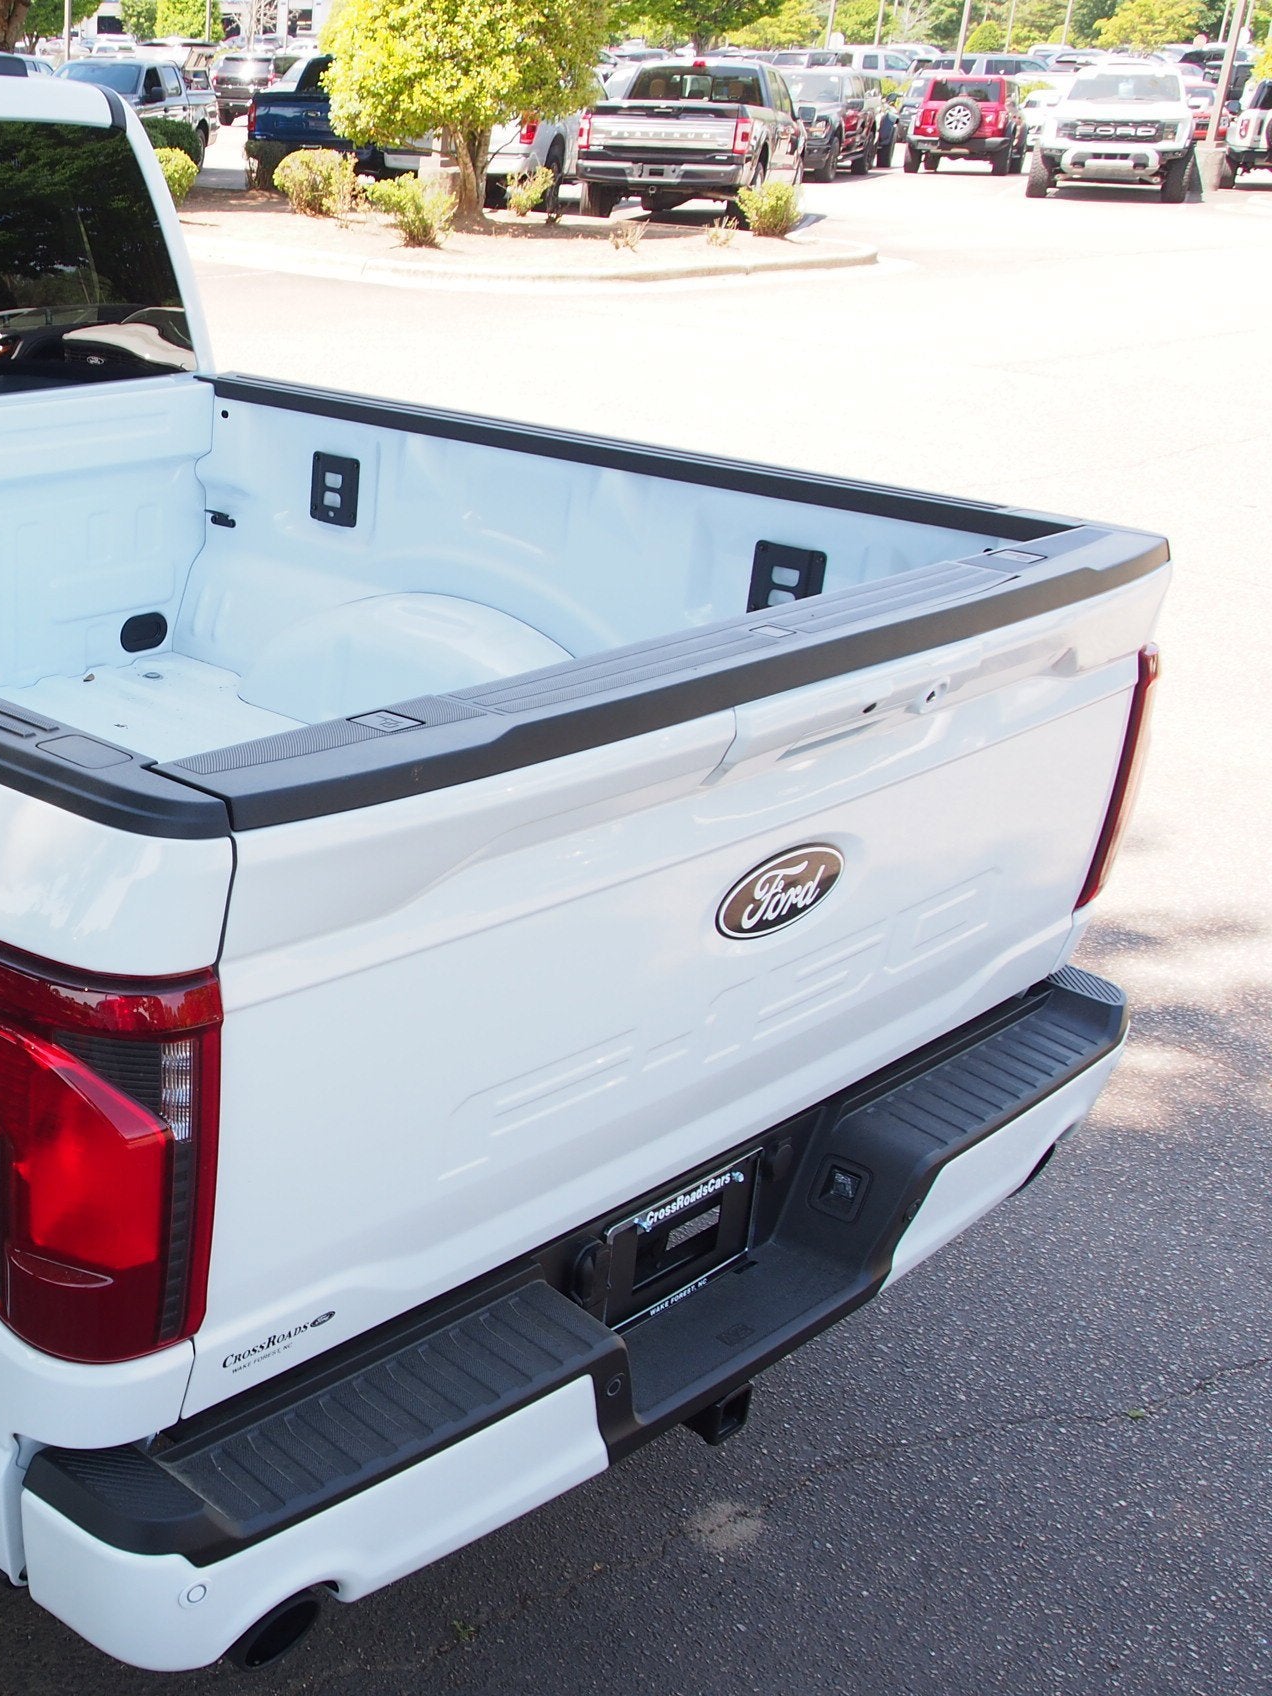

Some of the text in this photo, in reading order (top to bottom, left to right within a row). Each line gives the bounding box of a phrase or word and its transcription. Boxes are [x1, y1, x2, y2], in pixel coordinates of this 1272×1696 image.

[611, 130, 711, 139] PLATINUM
[1075, 126, 1157, 137] FORD
[741, 860, 826, 930] Ford
[646, 1173, 731, 1227] CrossRoadsCars
[650, 1301, 669, 1316] WAKE
[697, 1278, 707, 1288] NC
